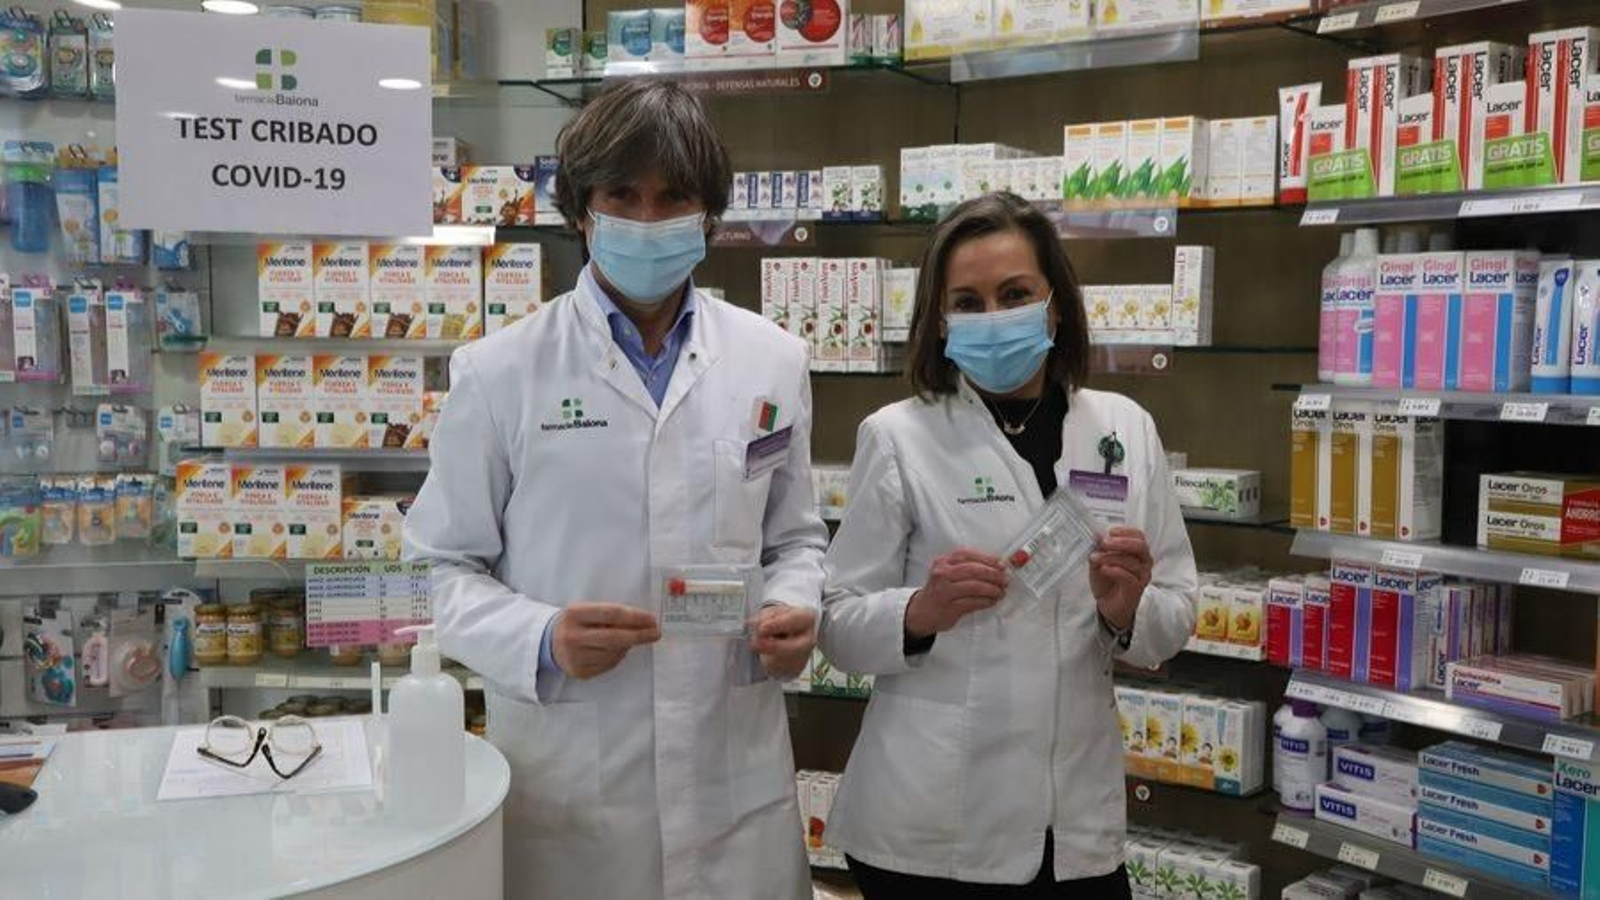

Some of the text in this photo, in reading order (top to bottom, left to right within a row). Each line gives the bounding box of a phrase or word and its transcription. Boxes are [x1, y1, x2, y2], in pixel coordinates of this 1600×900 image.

[1541, 41, 1555, 92] Lacer
[1570, 37, 1585, 88] Lacer
[1447, 55, 1459, 103] Lacer
[1474, 51, 1487, 100] Lacer
[1358, 66, 1372, 112] Lacer
[1384, 63, 1399, 110] Lacer
[1487, 100, 1522, 113] Lacer
[1311, 119, 1343, 130] Lacer
[1399, 112, 1430, 123] Lacer
[175, 117, 378, 146] TEST CRIBADO
[1401, 145, 1452, 165] GRATIS
[1488, 139, 1545, 161] GRATIS
[1312, 153, 1366, 175] GRATIS
[211, 164, 346, 190] COVID-19
[265, 257, 306, 268] Meritene
[320, 257, 361, 268] Meritene
[375, 258, 417, 268] Meritene
[432, 258, 472, 268] Meritene
[491, 259, 533, 269] Meritene
[1381, 261, 1414, 273] Gingi
[1424, 260, 1457, 273] Gingi
[1471, 258, 1508, 272] Gingi
[1380, 273, 1416, 285] Lacer
[1423, 272, 1459, 284] Lacer
[1470, 271, 1509, 284] Lacer
[1336, 288, 1375, 301] Lacer
[1574, 323, 1588, 365] Lacer
[206, 368, 247, 377] Meritene
[265, 368, 306, 377] Meritene
[319, 368, 361, 378] Meritene
[374, 369, 416, 378] Meritene
[185, 479, 225, 489] Meritene
[238, 480, 279, 490] Meritene
[292, 481, 333, 491] Meritene
[1488, 479, 1548, 495] Lacer Oros
[1487, 514, 1546, 531] Lacer Oros
[384, 564, 402, 574] UDS
[1332, 568, 1369, 584] Lacer
[1374, 575, 1412, 591] Lacer
[1270, 591, 1302, 605] Lacer
[1435, 651, 1447, 686] Lacer
[1452, 676, 1481, 688] Lacer
[1340, 761, 1373, 779] VITIS
[1423, 755, 1480, 776] Lacer Fresh
[1557, 760, 1592, 779] Xero
[1555, 773, 1600, 795] Lacer
[1422, 788, 1479, 811] Lacer Fresh
[1321, 797, 1354, 817] VITIS
[1421, 821, 1478, 845] Lacer Fresh
